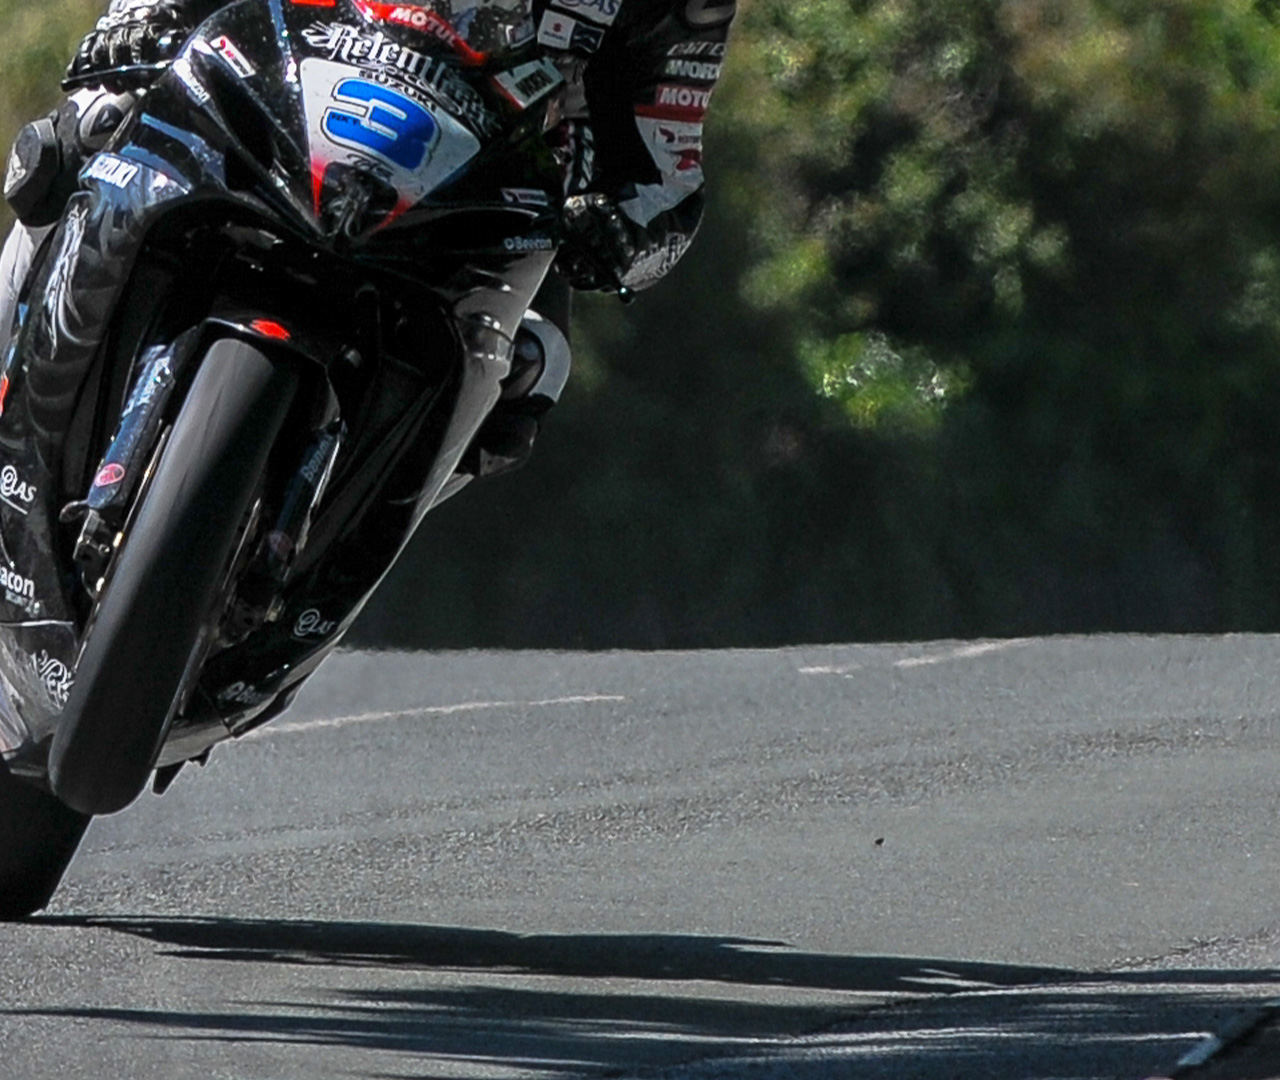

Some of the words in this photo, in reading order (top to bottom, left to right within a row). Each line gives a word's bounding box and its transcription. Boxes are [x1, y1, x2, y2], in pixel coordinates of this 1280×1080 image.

[391, 7, 456, 48] MOTUL
[660, 87, 710, 109] MOTU
[320, 76, 441, 172] 3
